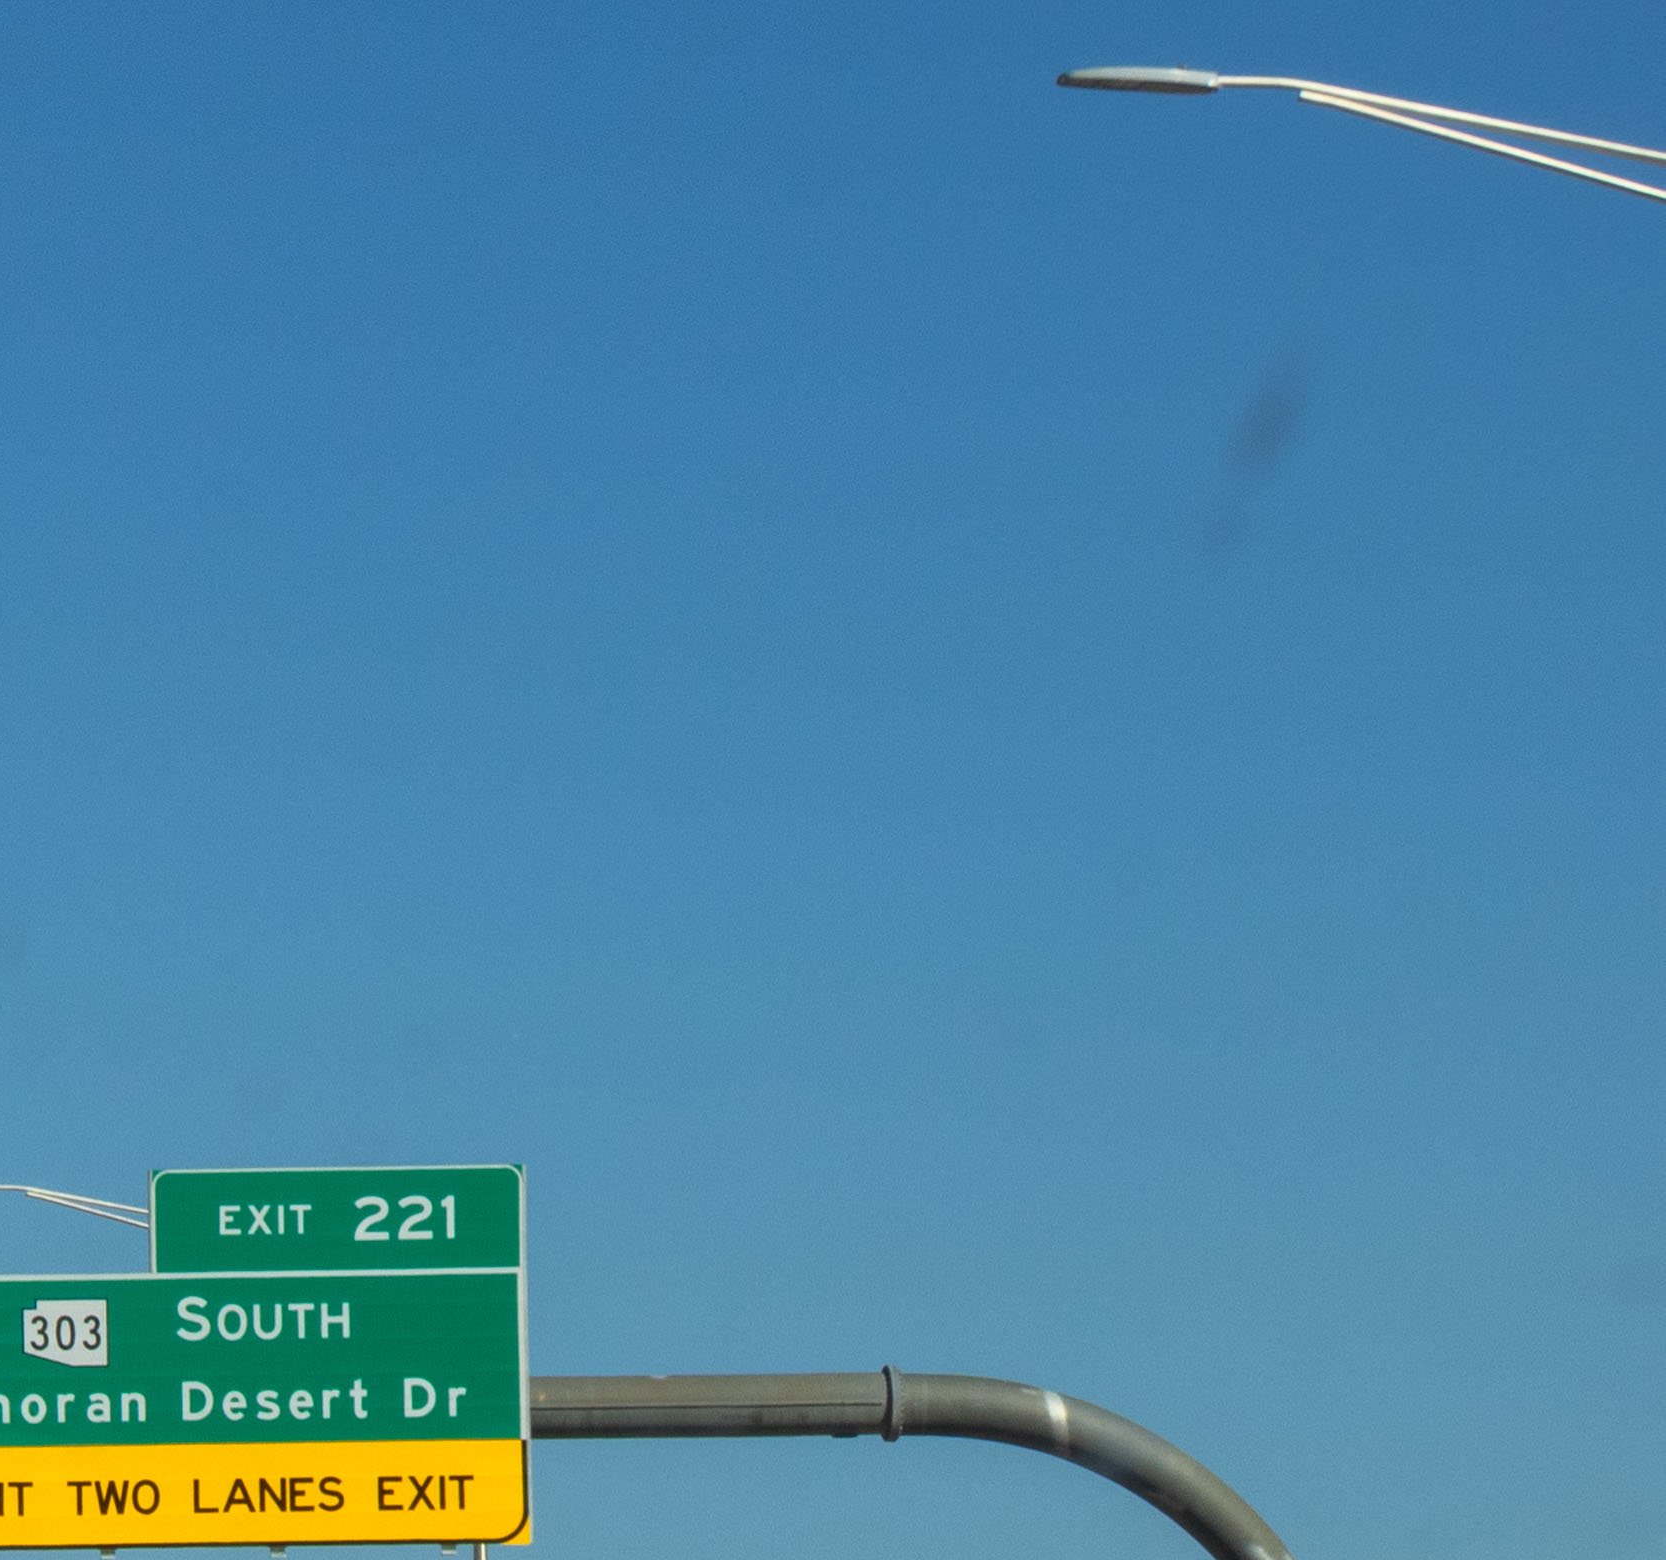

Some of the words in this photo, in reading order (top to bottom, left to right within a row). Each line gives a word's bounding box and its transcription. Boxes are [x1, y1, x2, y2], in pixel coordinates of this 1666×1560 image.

[218, 1203, 312, 1236] EXIT
[353, 1194, 457, 1242] 221
[29, 1313, 104, 1352] 303
[175, 1295, 352, 1342] SOUTH
[180, 1379, 369, 1423] Desert
[403, 1377, 468, 1419] Dr
[67, 1479, 161, 1516] TWO
[192, 1476, 346, 1515] LANES
[376, 1474, 475, 1512] EXIT
